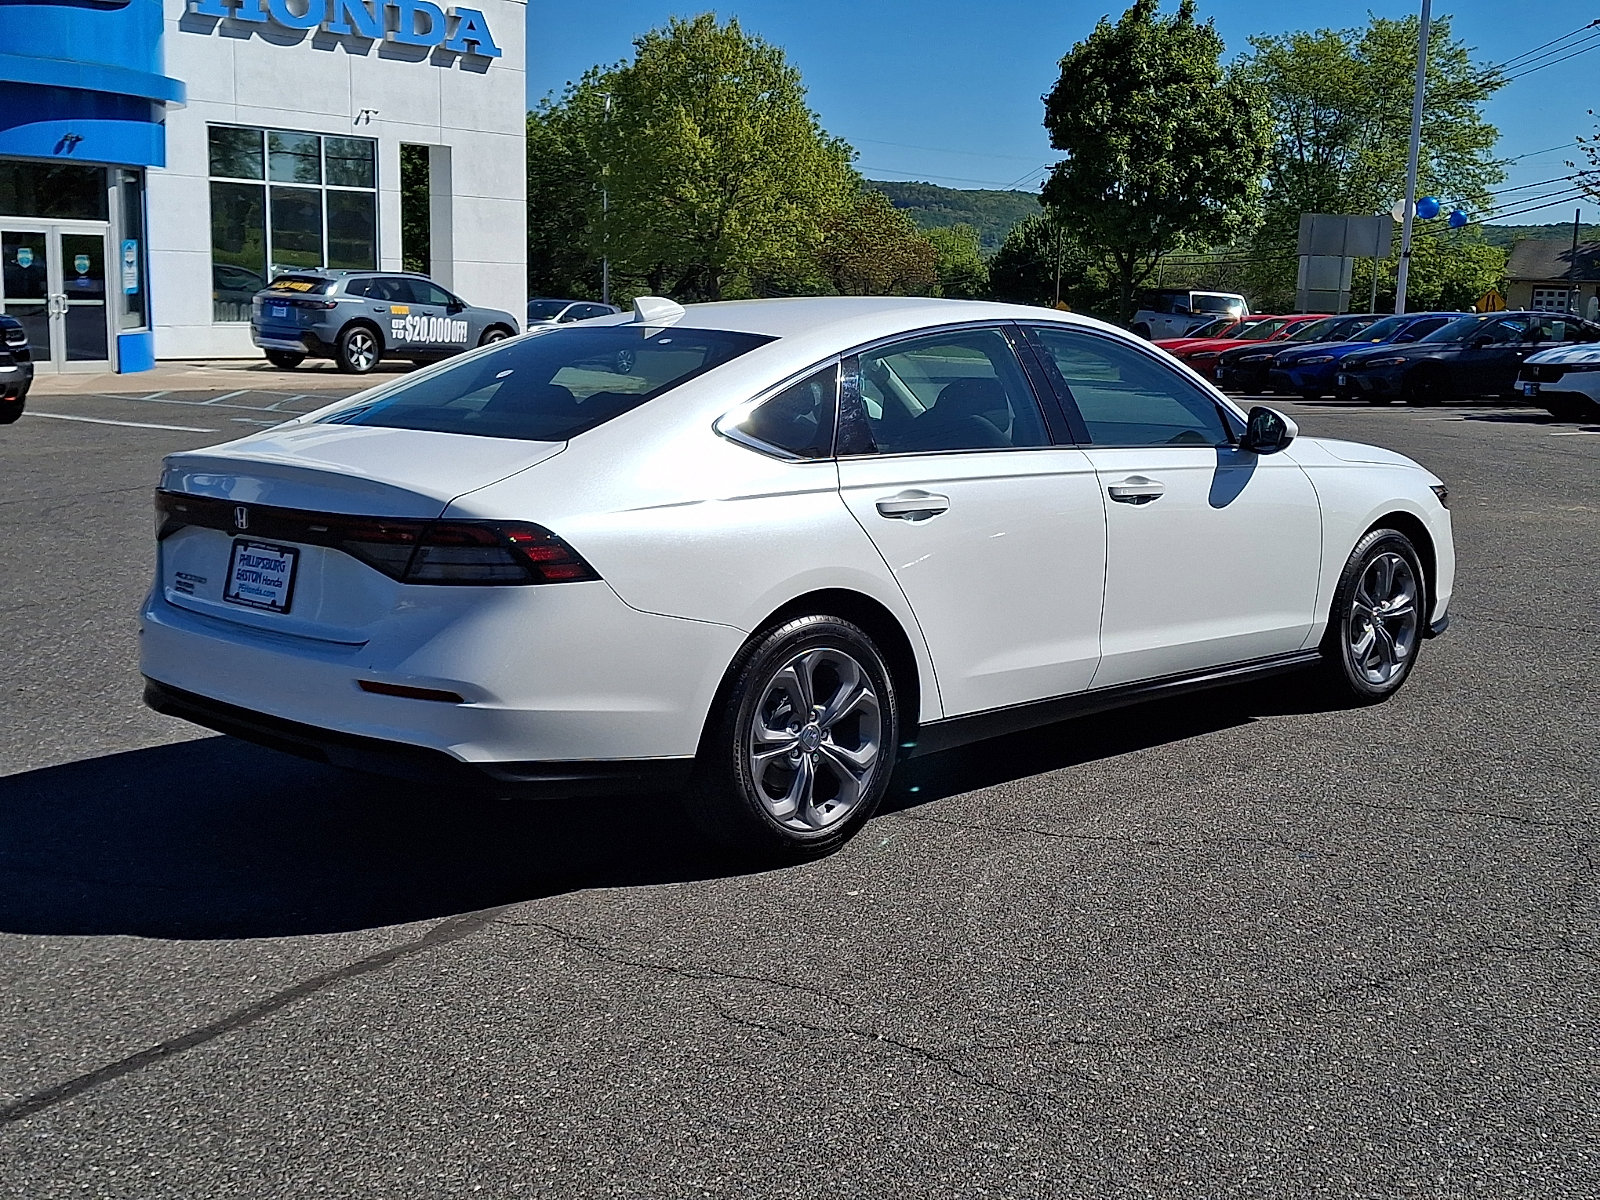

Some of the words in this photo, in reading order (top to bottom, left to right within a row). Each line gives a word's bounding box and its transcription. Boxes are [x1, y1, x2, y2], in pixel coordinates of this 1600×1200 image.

[391, 319, 405, 329] UP
[405, 315, 451, 344] $20,000
[451, 320, 468, 343] OFF!
[391, 329, 404, 339] TO
[239, 554, 286, 573] PHILLIPSBURG
[236, 569, 262, 584] EASTON
[262, 576, 282, 588] Honda
